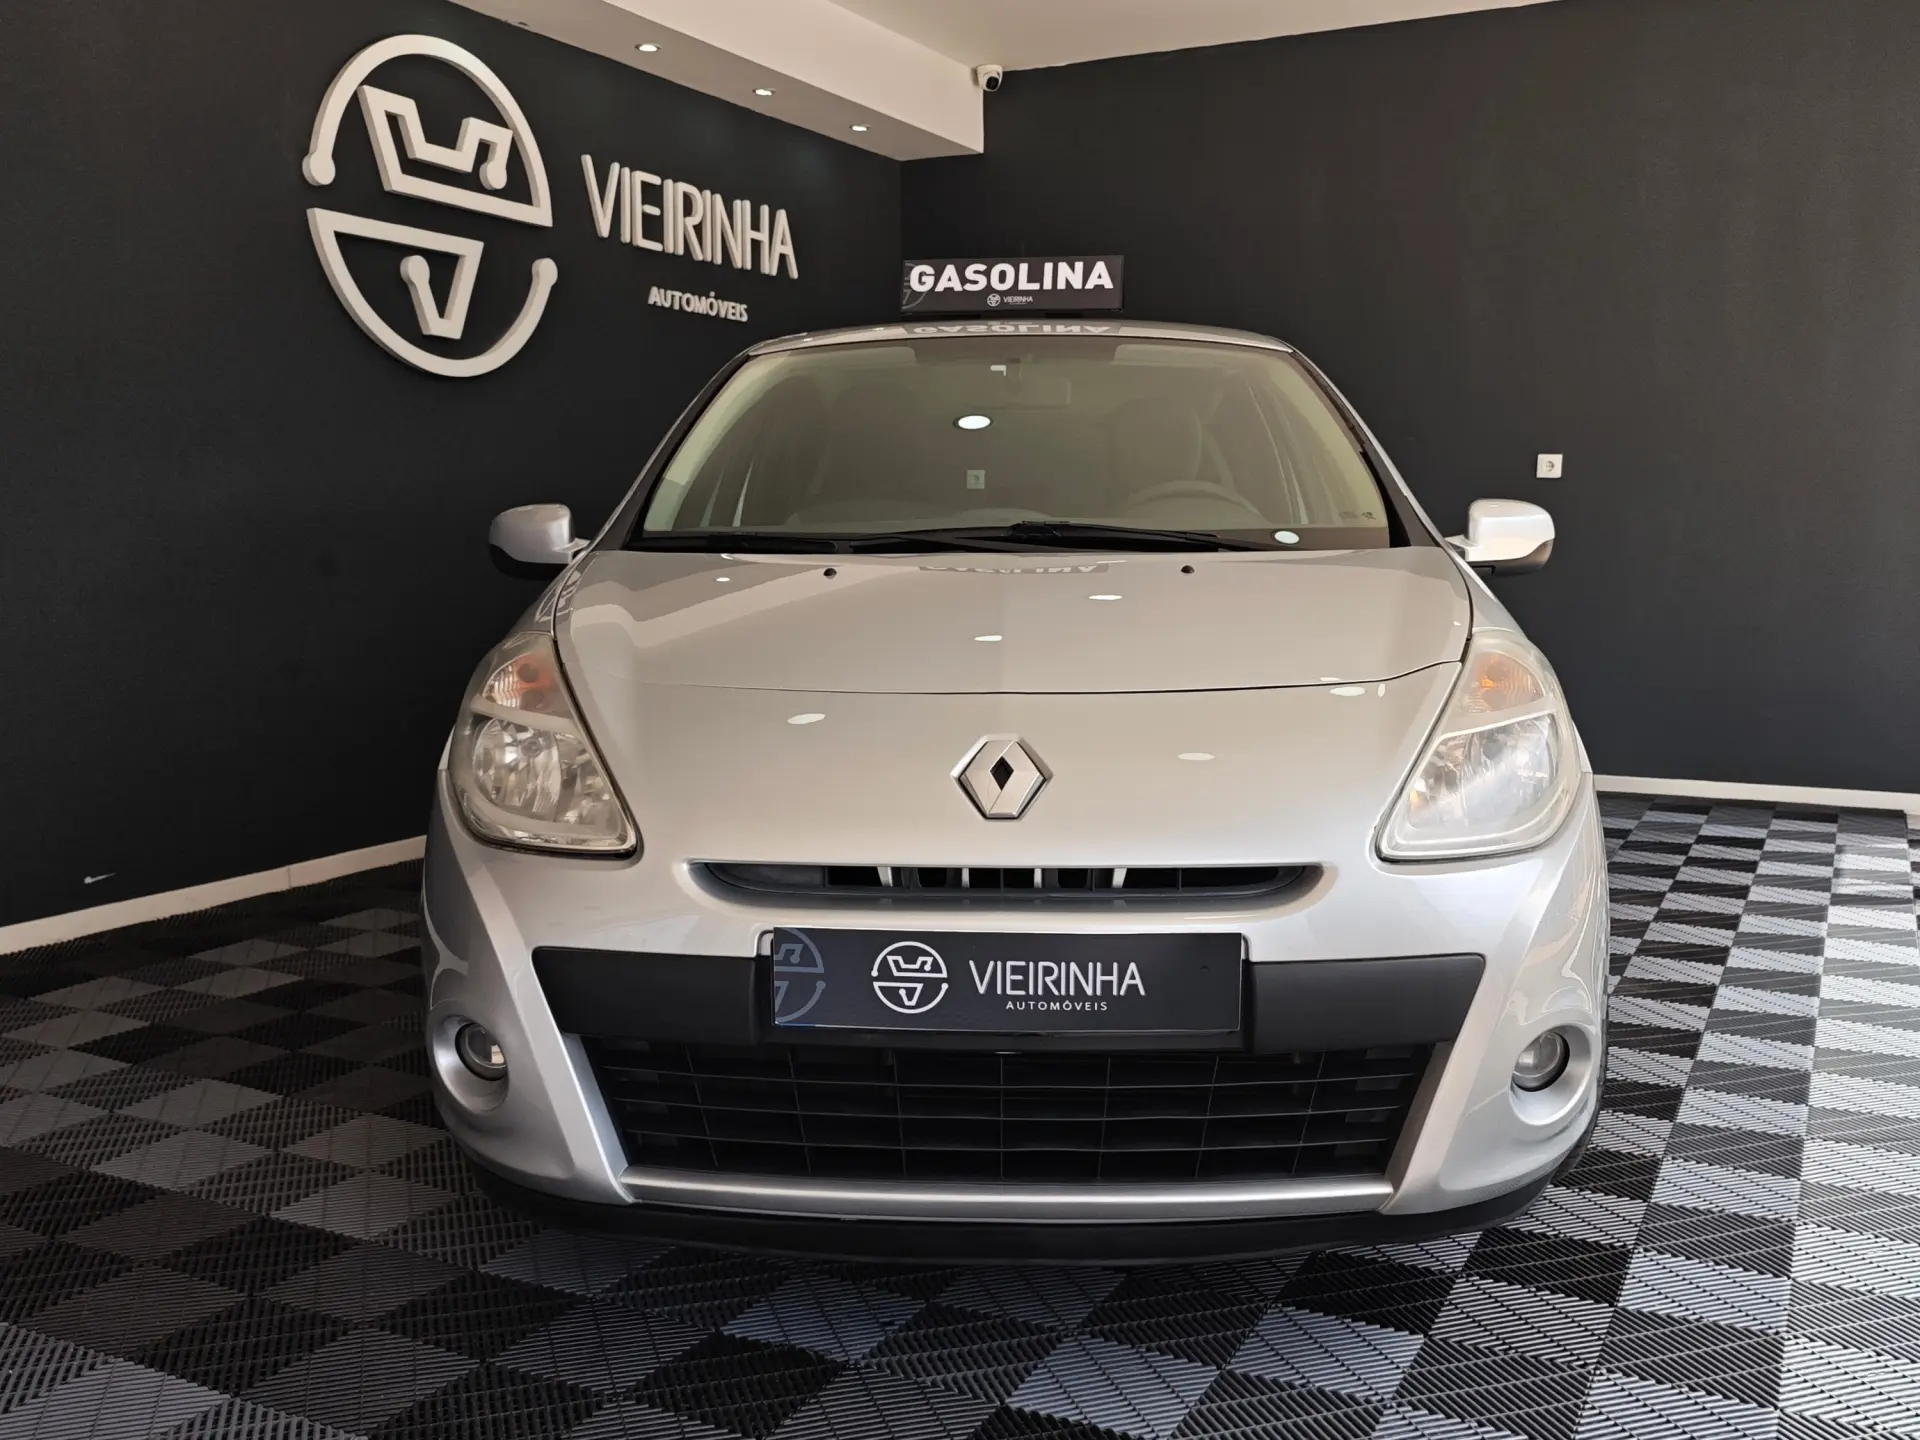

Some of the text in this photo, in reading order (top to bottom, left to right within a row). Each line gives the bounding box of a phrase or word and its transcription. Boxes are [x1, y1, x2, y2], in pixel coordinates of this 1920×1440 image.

[581, 154, 798, 280] VIEIRINHA
[909, 261, 1114, 292] GASOLINA
[648, 286, 748, 322] AUTOMÓVEIS
[969, 960, 1146, 996] VIEIRINHA
[1006, 1000, 1108, 1011] AUTOMÓVEIS
